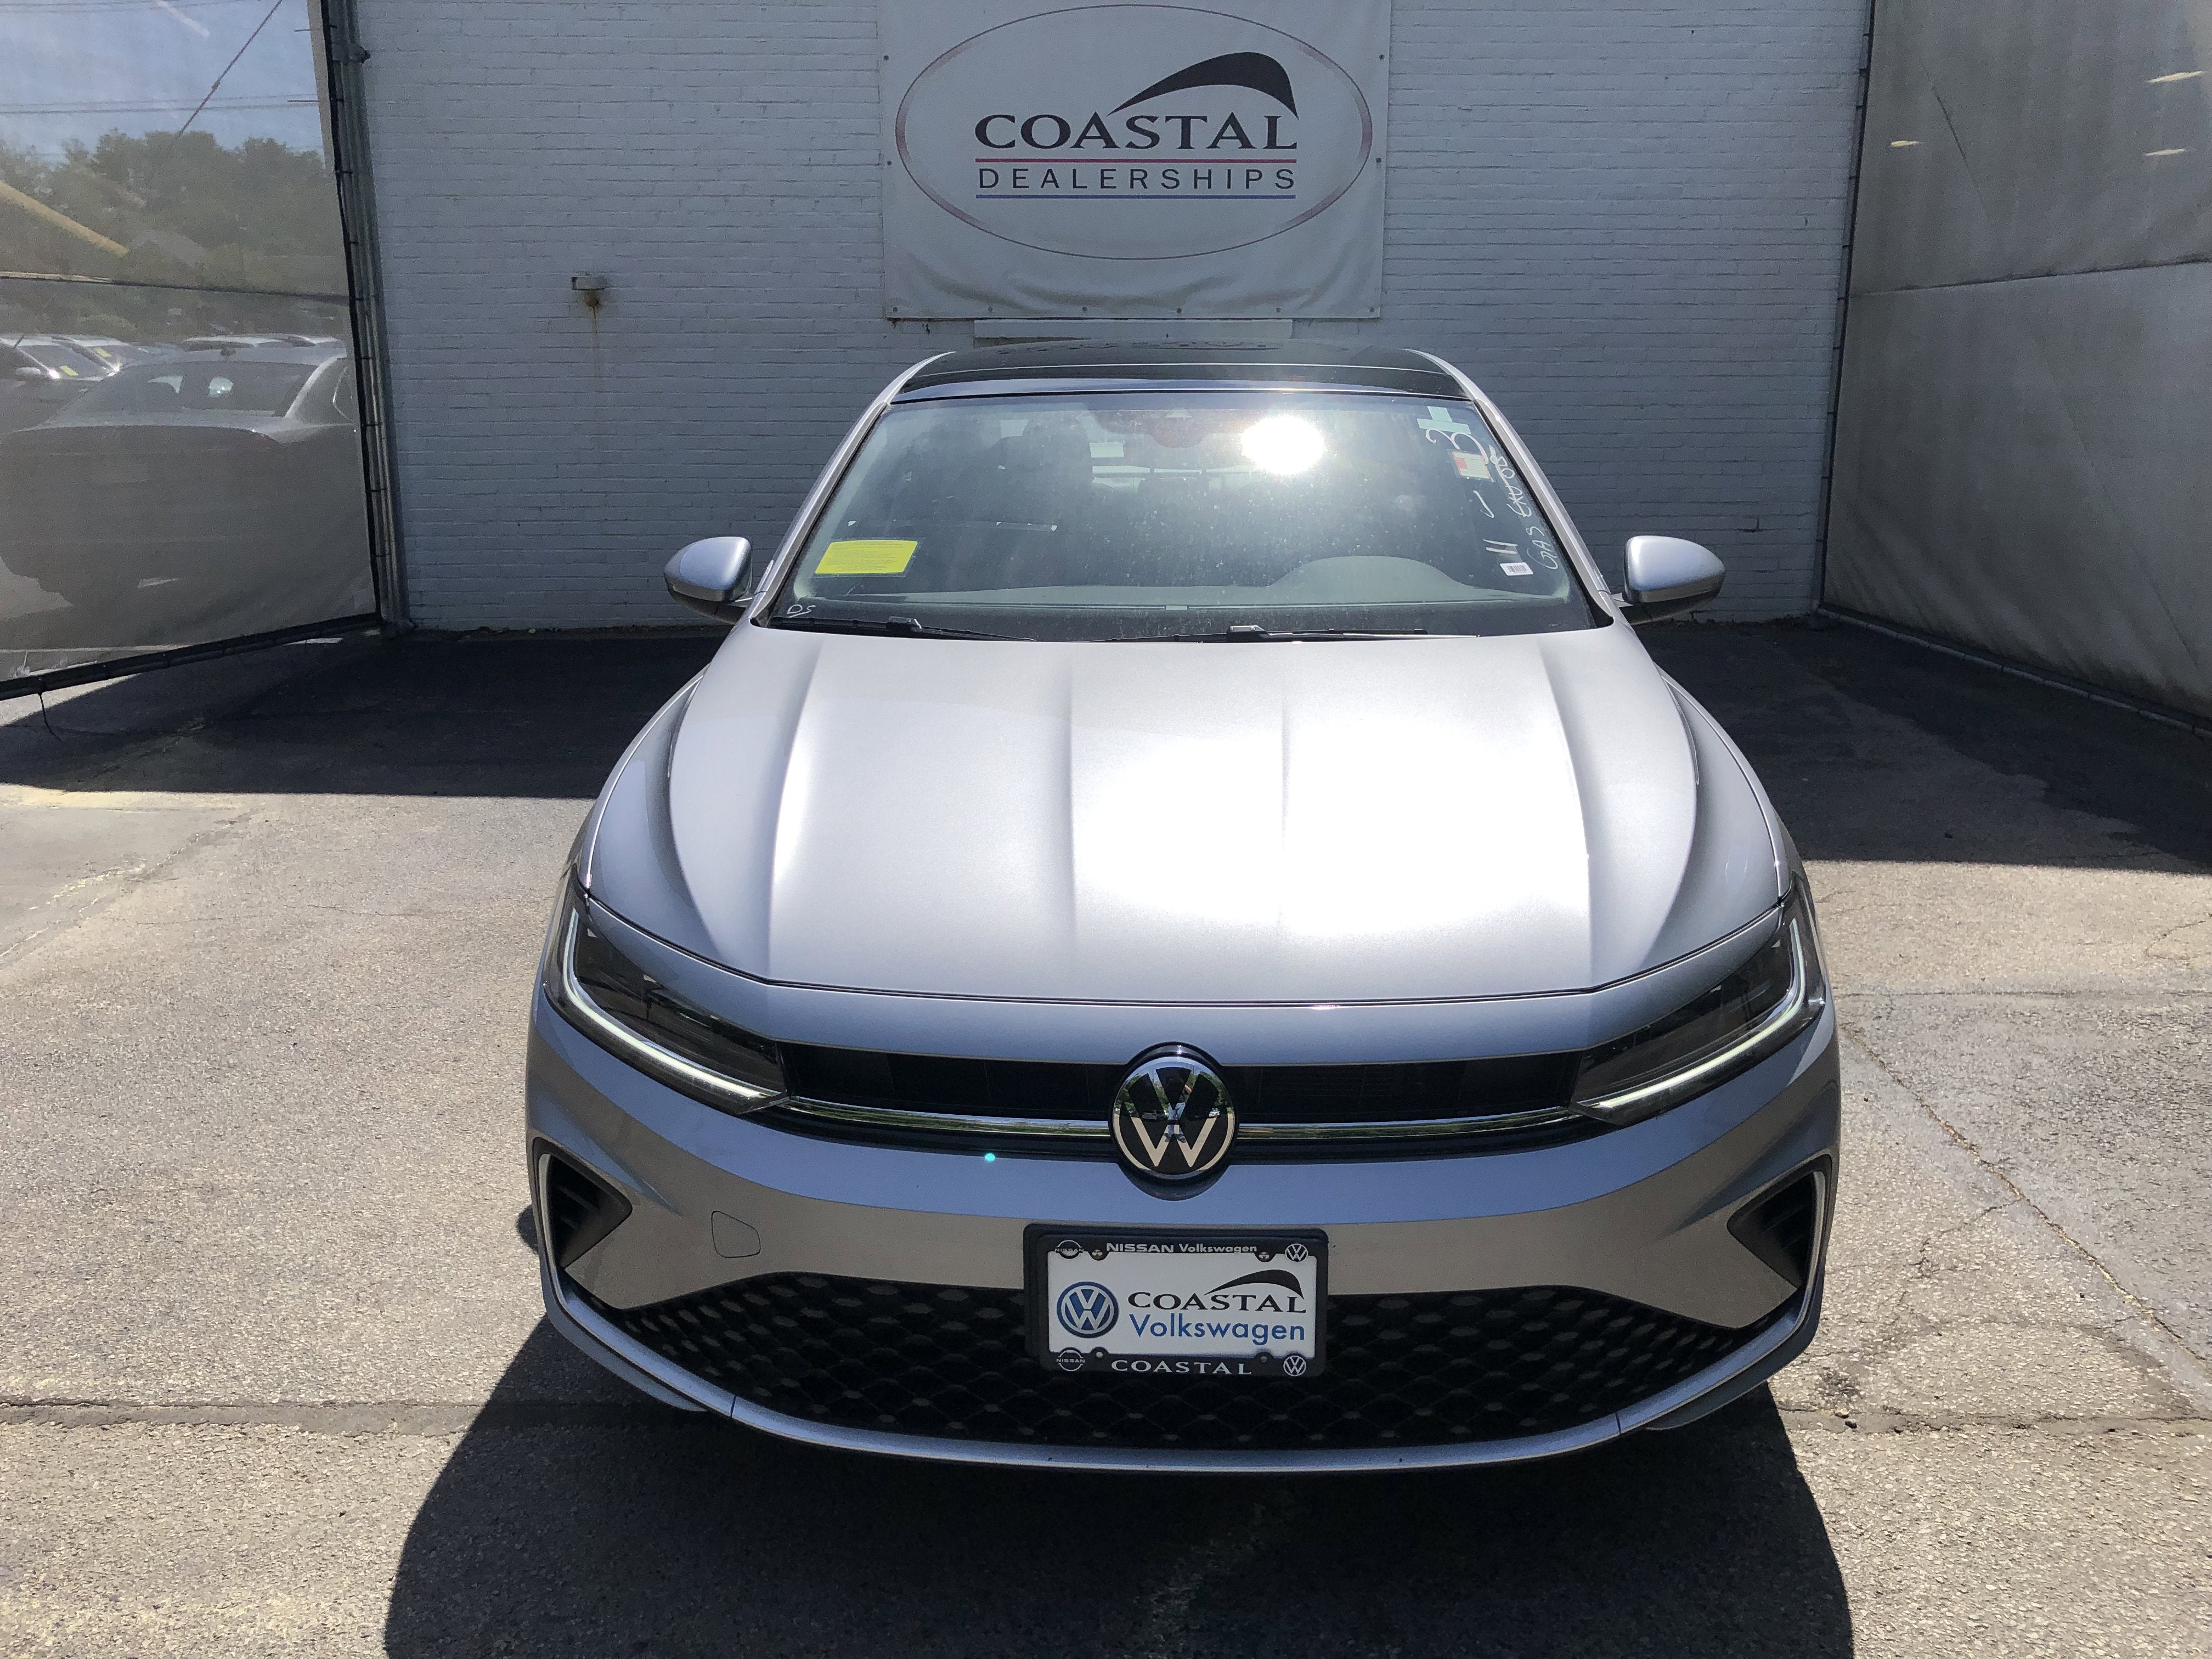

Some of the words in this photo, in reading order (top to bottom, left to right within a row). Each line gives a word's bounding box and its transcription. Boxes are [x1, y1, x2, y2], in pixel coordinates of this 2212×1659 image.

[974, 111, 1297, 150] COASTAL
[979, 168, 1295, 190] DEALERSHIPS
[1526, 526, 1559, 570] GAS
[1106, 1242, 1174, 1252] NISSAN
[1179, 1243, 1257, 1254] Volkswagen
[1128, 1291, 1306, 1313] COASTAL
[1129, 1313, 1305, 1345] Volkswagen
[1111, 1359, 1251, 1375] COASTAL
